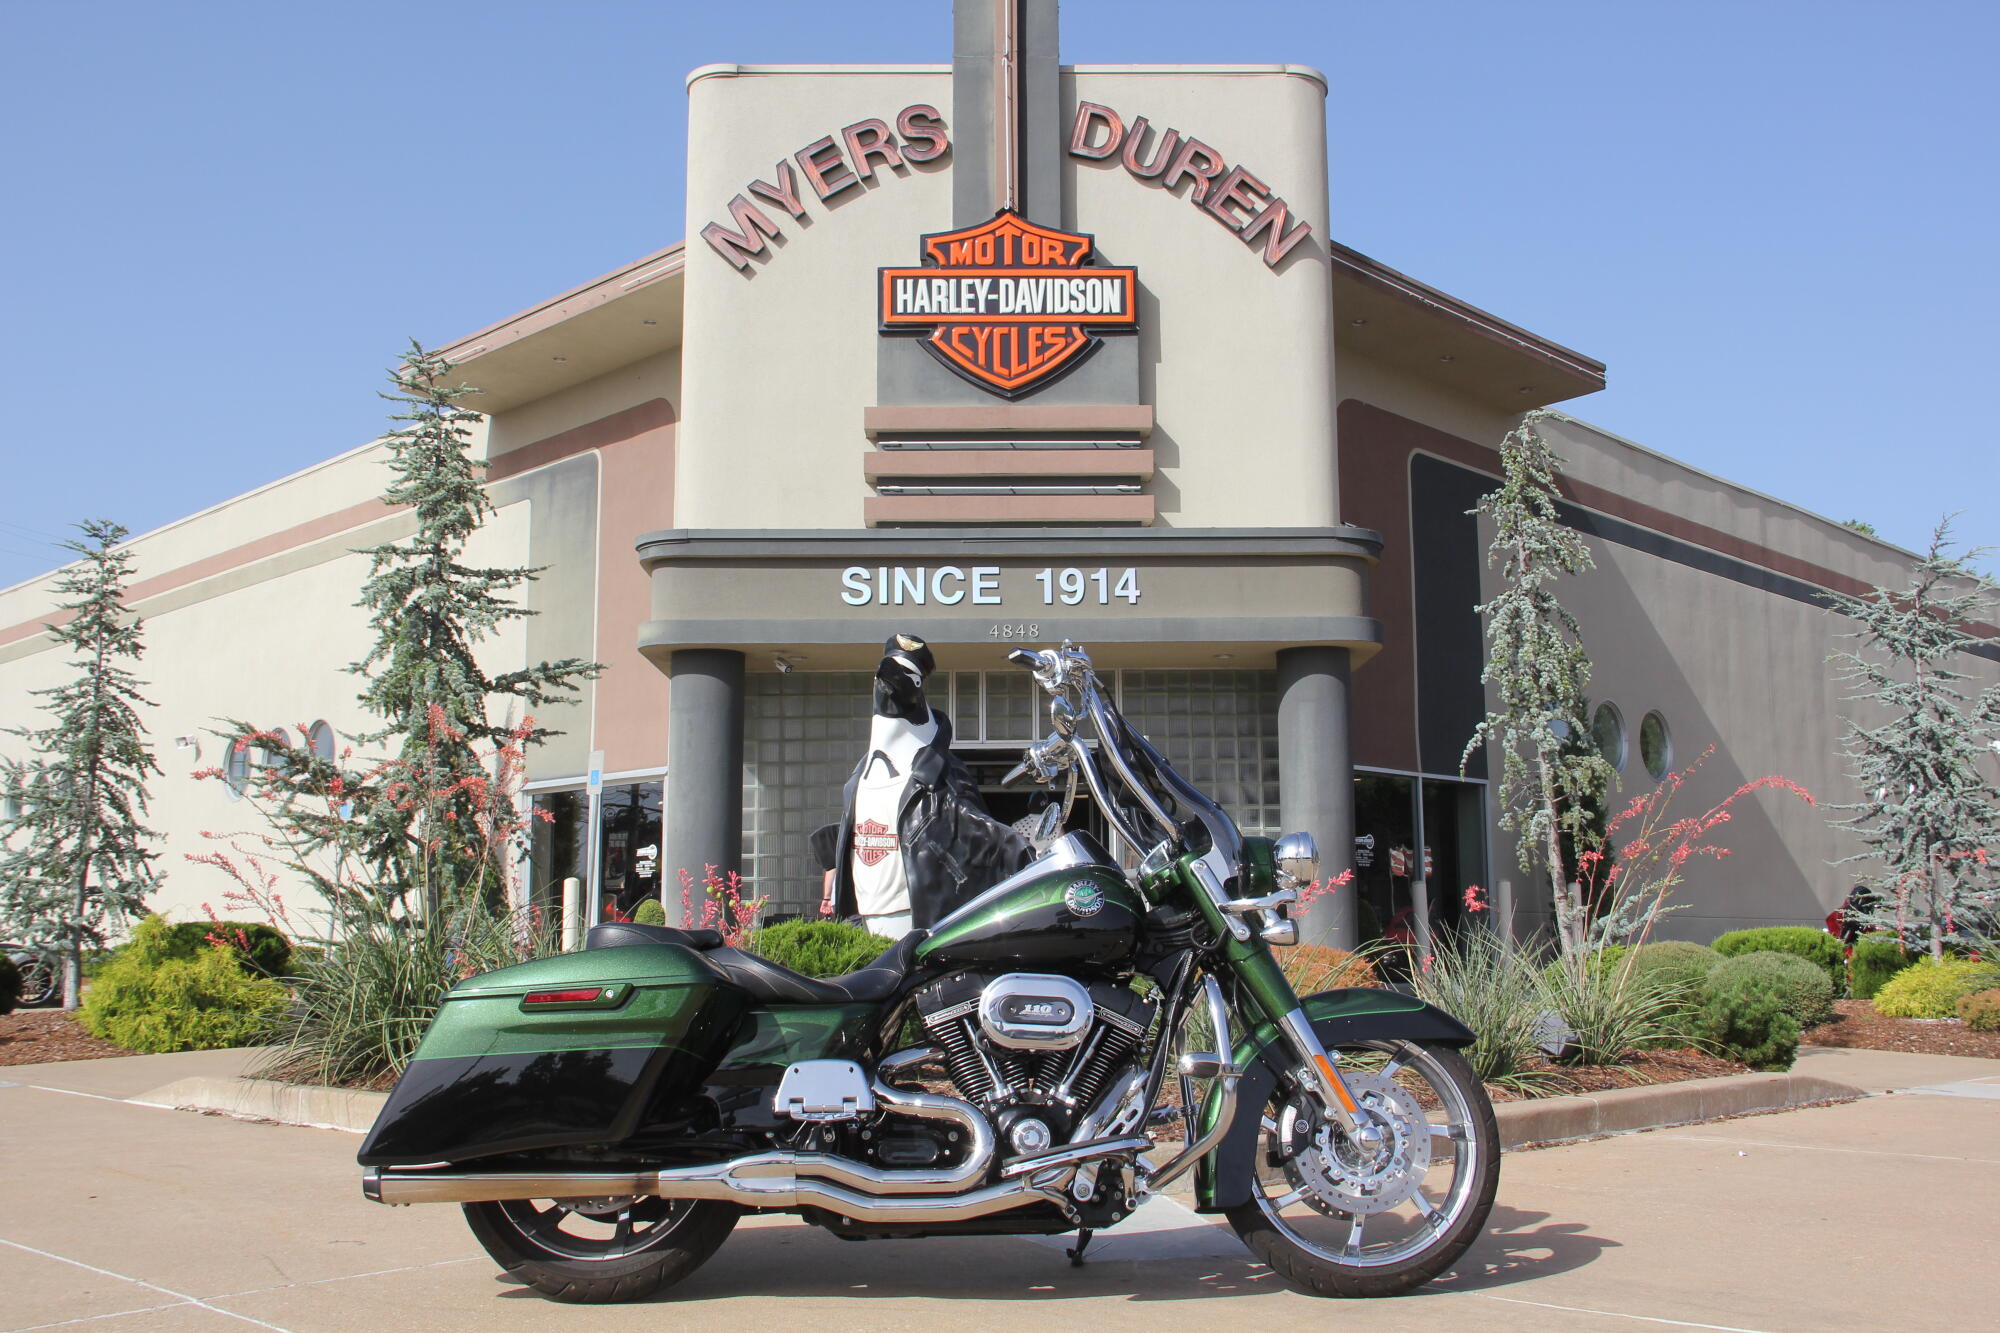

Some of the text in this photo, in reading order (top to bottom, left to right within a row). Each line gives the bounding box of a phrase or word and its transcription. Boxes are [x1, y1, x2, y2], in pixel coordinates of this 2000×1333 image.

[701, 101, 1313, 271] MYERS DUREN
[950, 231, 1067, 266] MOTOR
[896, 278, 1122, 315] HARLEY-DAVIDSON
[951, 326, 1067, 378] CYCLES
[841, 566, 1141, 605] SINCE 1914
[989, 623, 1040, 639] 4848
[1024, 1004, 1053, 1014] 110
